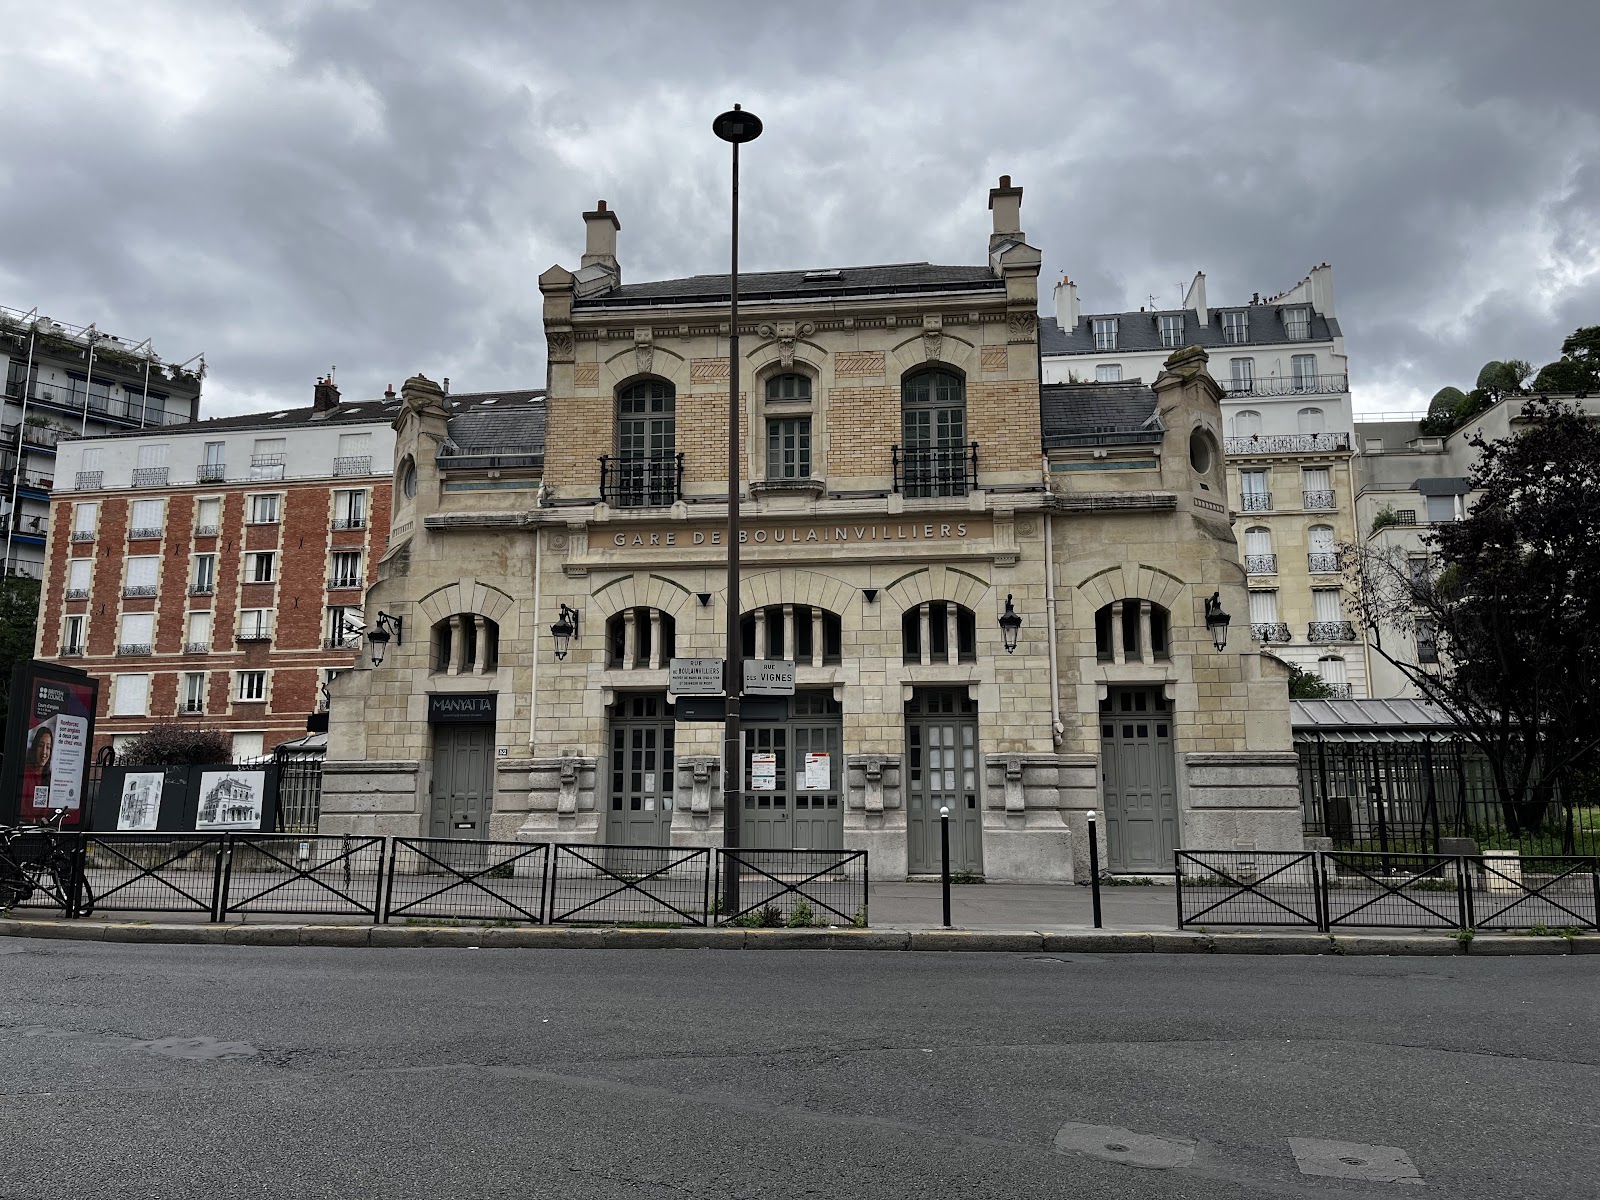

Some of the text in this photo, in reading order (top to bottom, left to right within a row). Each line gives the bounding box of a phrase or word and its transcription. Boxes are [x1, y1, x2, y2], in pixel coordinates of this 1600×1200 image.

[613, 522, 968, 547] GARE DE BOULAINVILLIERS
[679, 667, 720, 675] BOULAINVILLIERS
[760, 673, 792, 682] VIGNES
[48, 694, 65, 702] COUNCIL
[432, 698, 492, 711] MANYATTA
